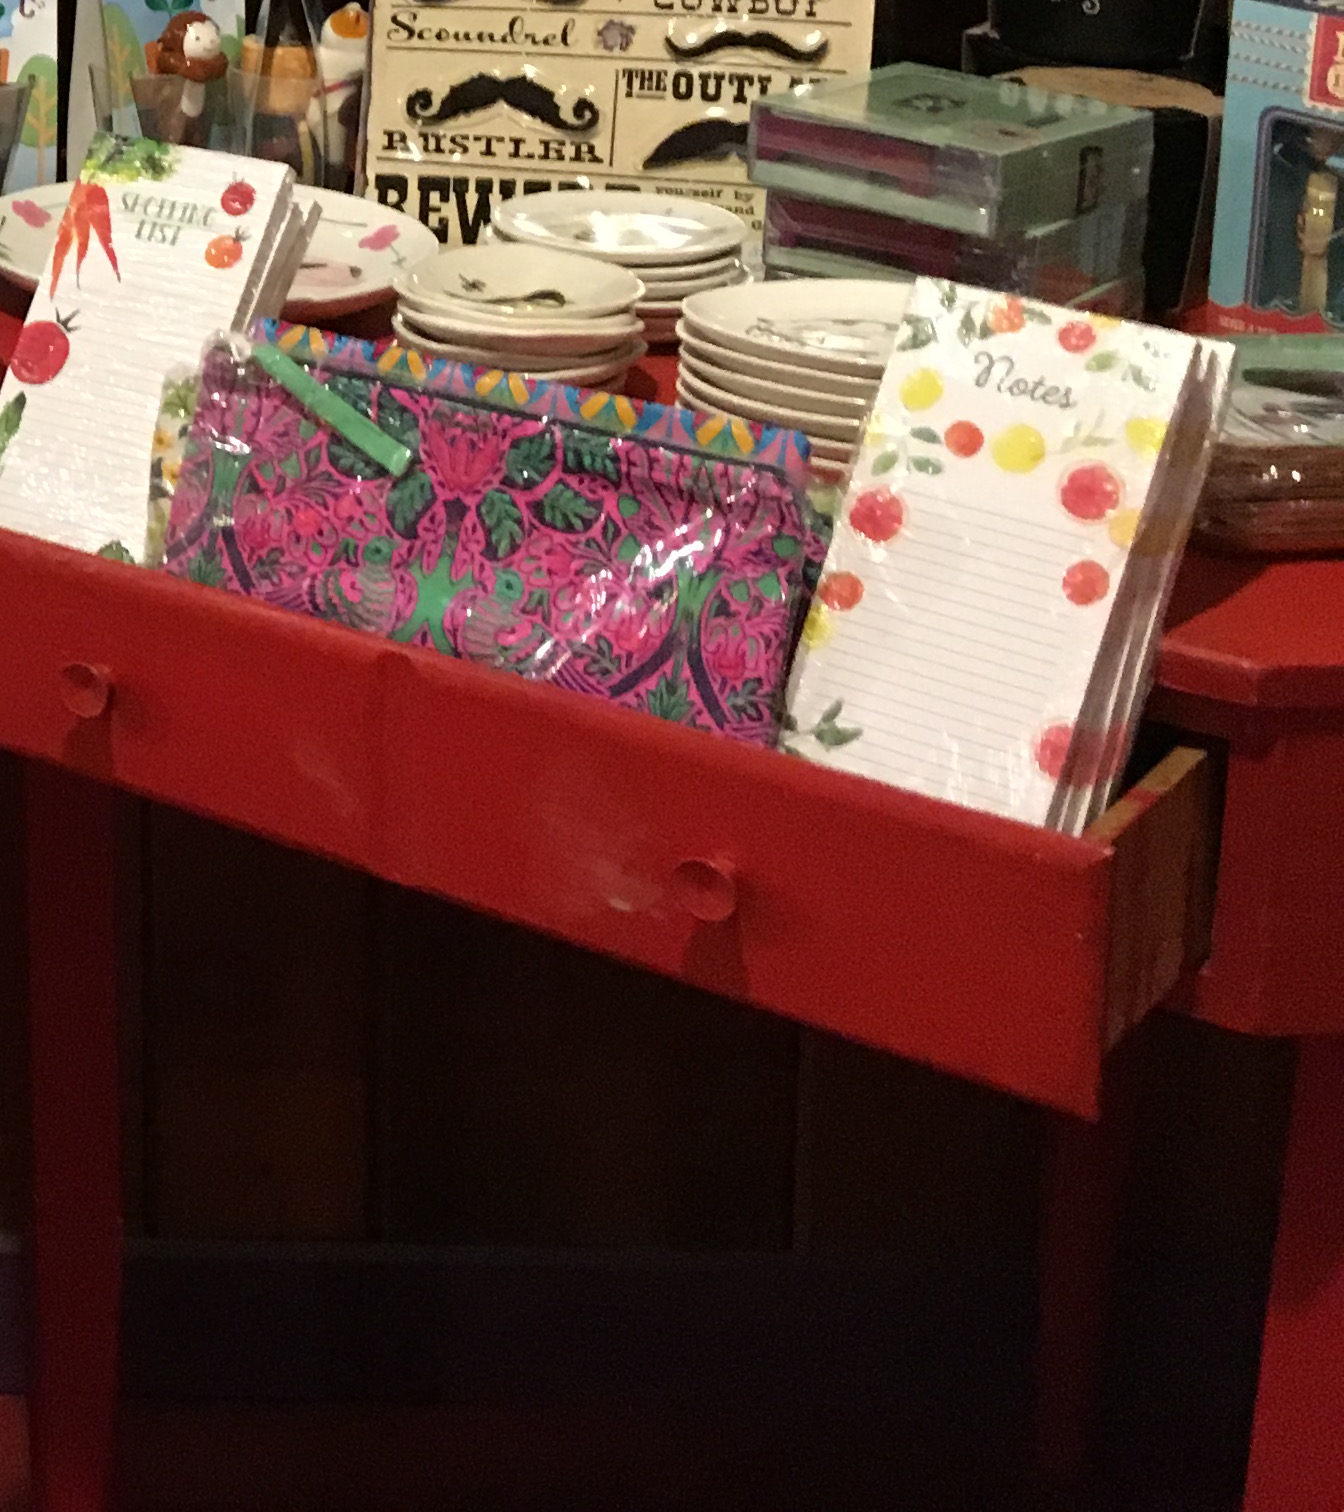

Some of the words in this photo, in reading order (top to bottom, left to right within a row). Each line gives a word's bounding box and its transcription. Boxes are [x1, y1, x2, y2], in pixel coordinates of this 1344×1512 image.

[386, 13, 577, 47] Scoundrel
[621, 67, 669, 99] THE
[382, 129, 605, 165] RUSTLER
[972, 350, 1078, 409] Notes
